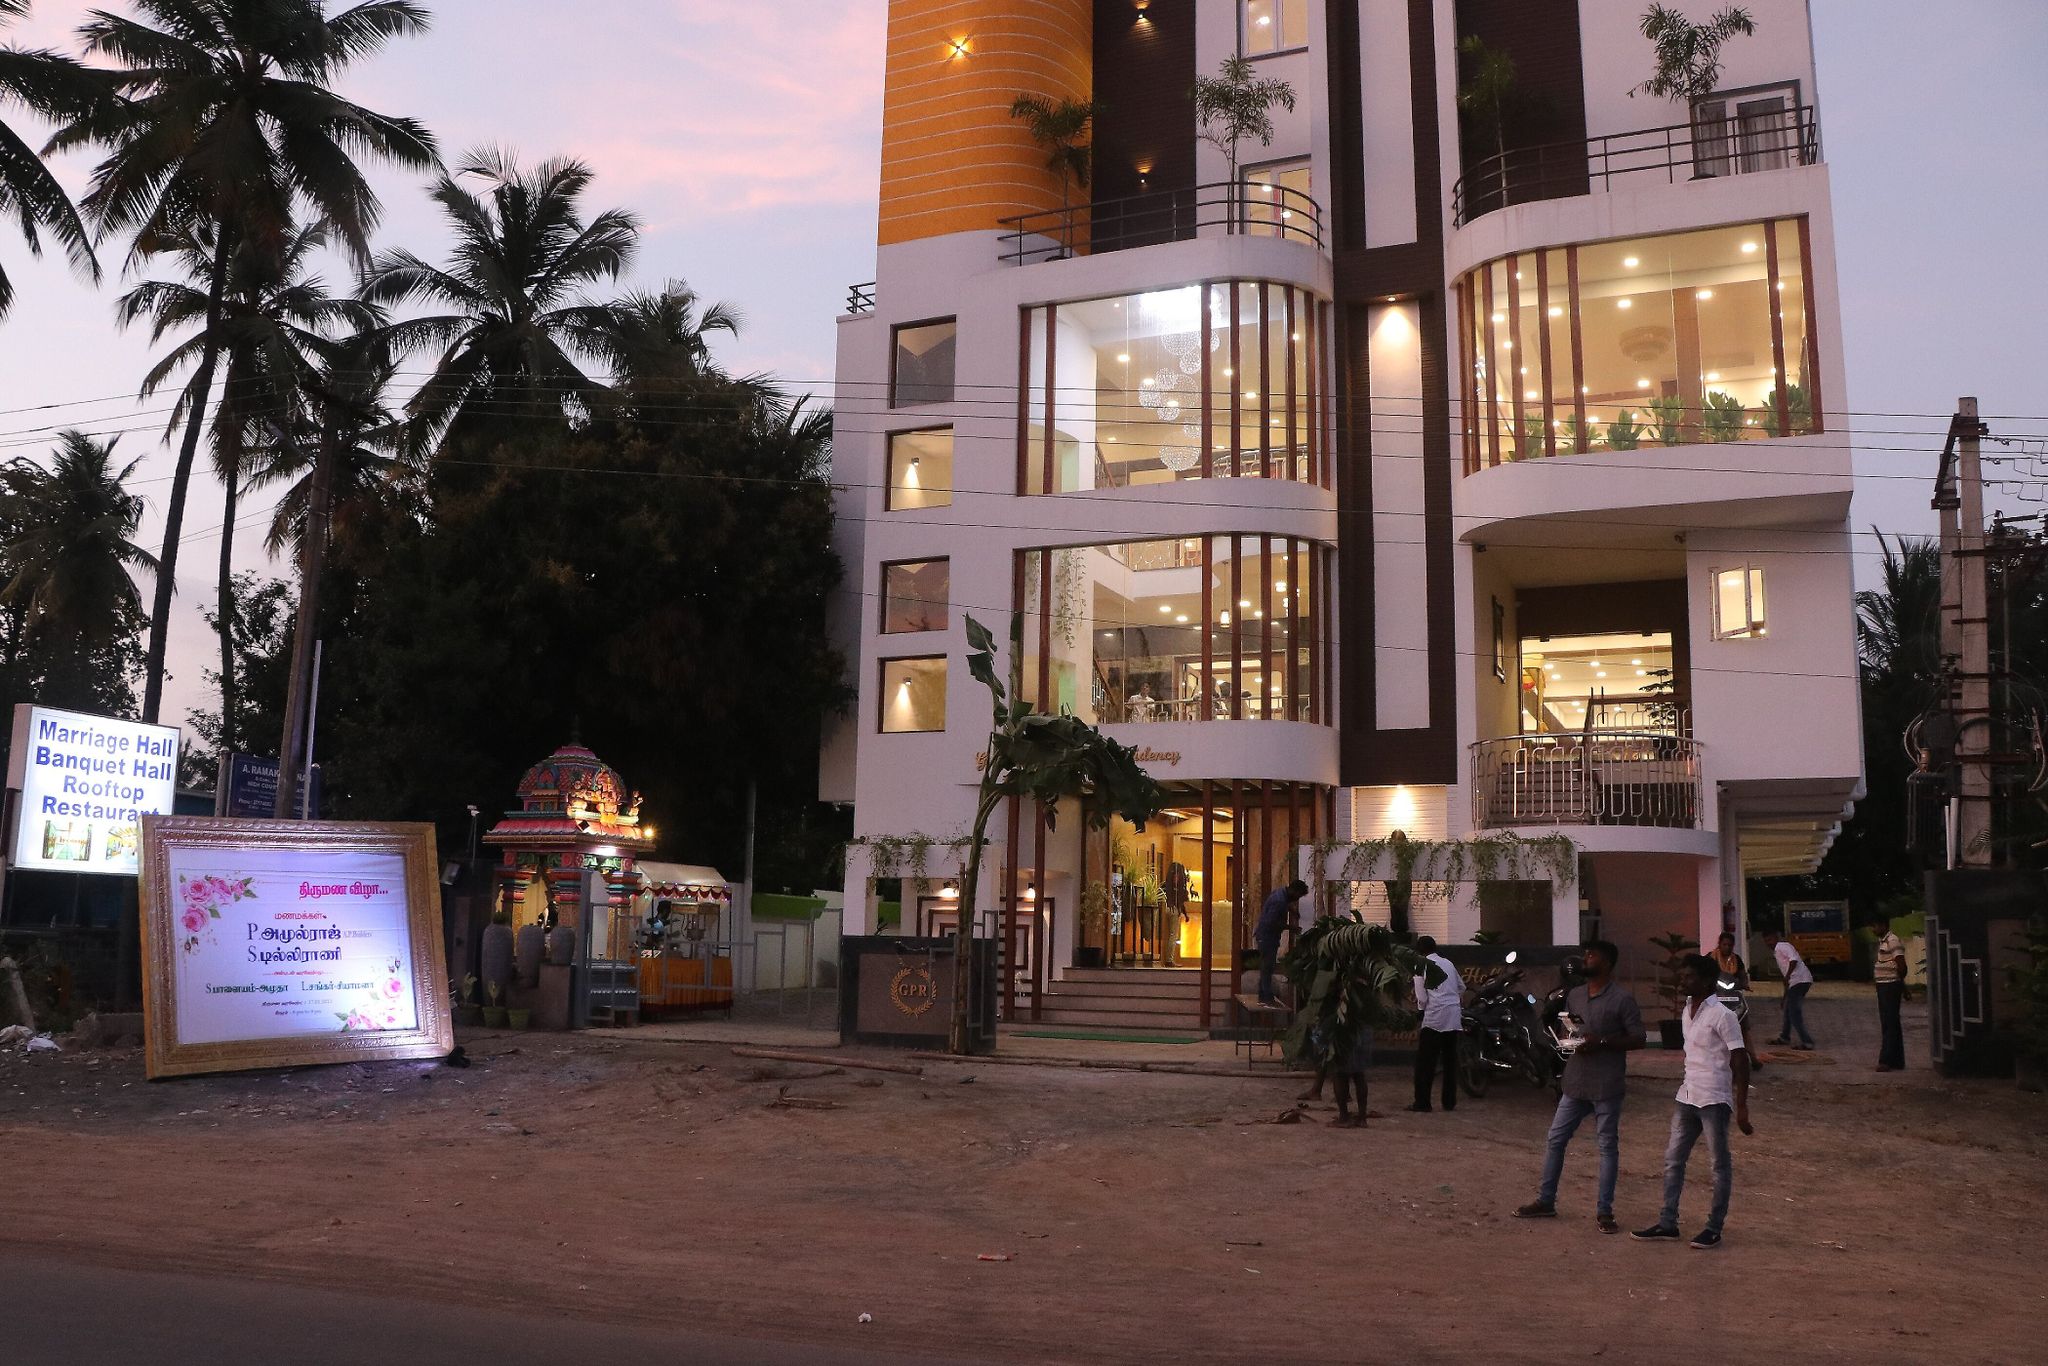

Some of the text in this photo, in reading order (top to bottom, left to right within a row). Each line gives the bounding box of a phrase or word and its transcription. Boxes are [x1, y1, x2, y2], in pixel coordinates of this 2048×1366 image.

[39, 719, 172, 757] Marriage Hall
[35, 746, 171, 781] Banquet Hall
[63, 775, 144, 804] Rooftop
[299, 881, 347, 900] திருமண
[899, 983, 929, 998] GPR
